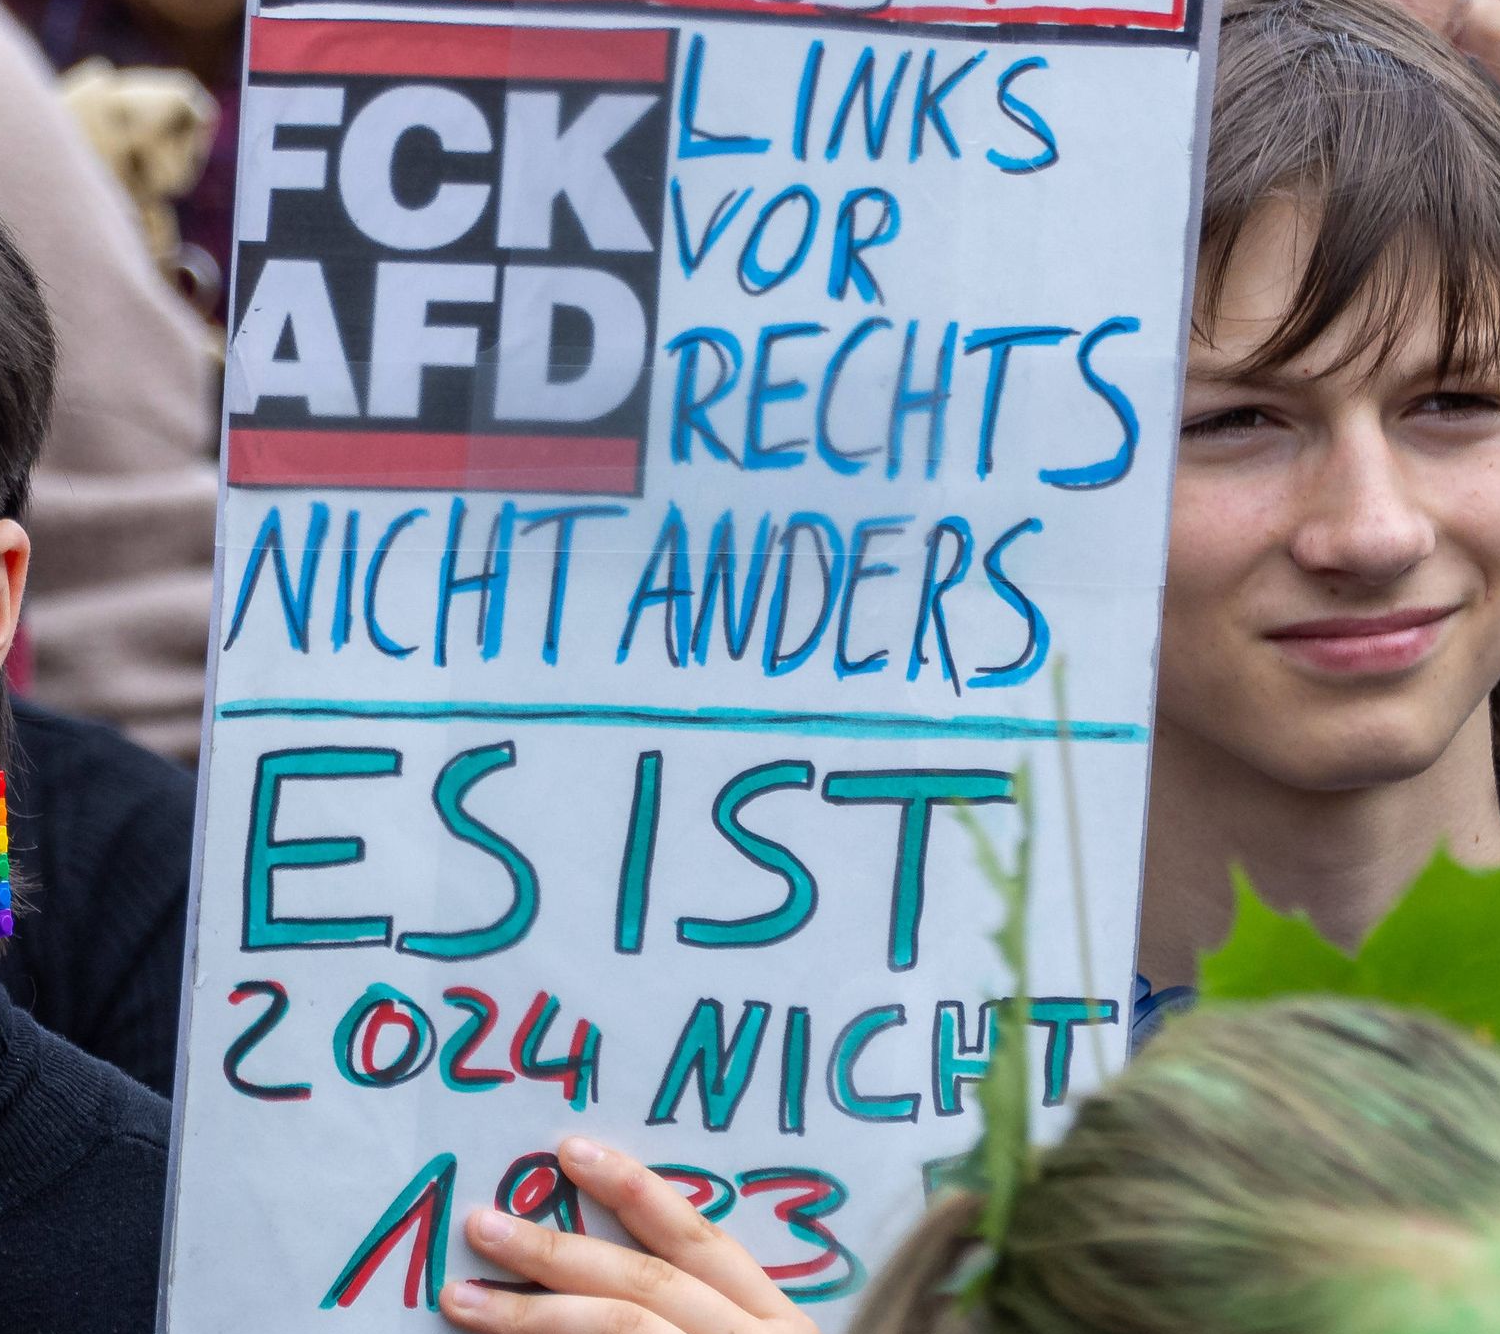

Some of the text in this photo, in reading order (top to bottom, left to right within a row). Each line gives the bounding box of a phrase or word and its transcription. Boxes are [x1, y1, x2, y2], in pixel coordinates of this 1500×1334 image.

[238, 86, 664, 254] FCK
[674, 33, 1063, 176] LINKS
[667, 177, 904, 307] VOR
[229, 259, 649, 423] AFD
[665, 315, 1143, 489] RECHTS
[222, 498, 1053, 696] NICHT ANDERS
[238, 739, 1016, 973] ES IST
[222, 979, 1120, 1137] 2024 NICHT
